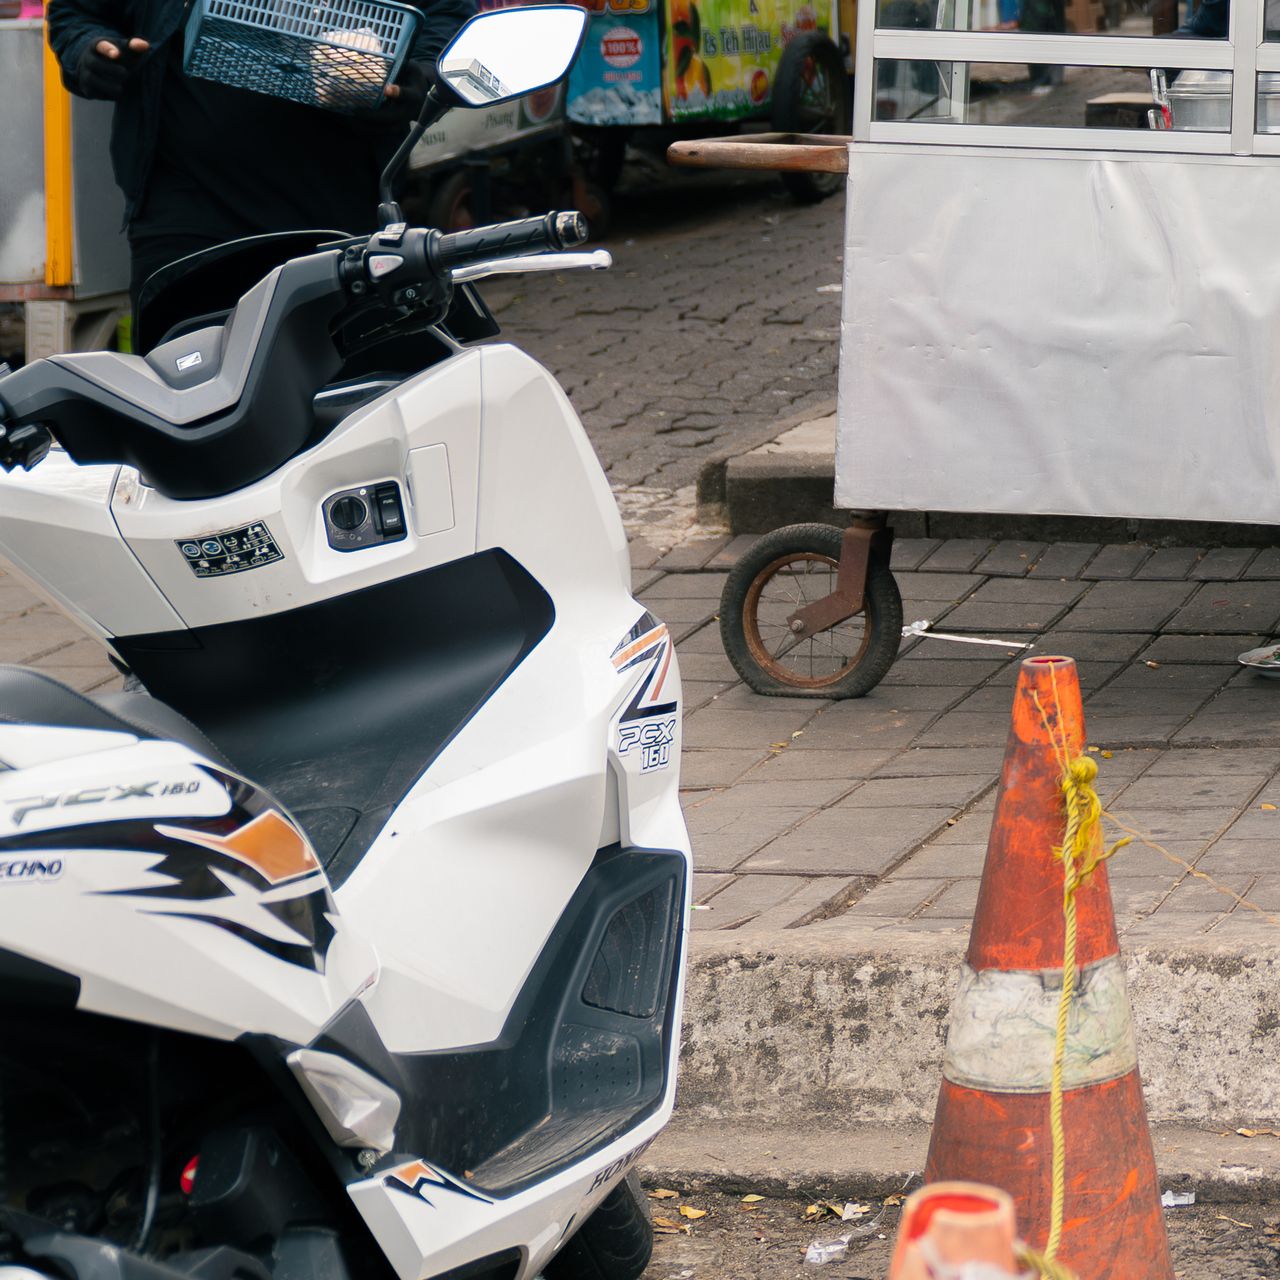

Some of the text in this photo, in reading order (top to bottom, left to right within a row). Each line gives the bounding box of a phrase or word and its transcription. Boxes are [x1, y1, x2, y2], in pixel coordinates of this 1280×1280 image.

[619, 719, 676, 753] PCX
[642, 743, 669, 770] 160
[5, 781, 159, 826] PCX
